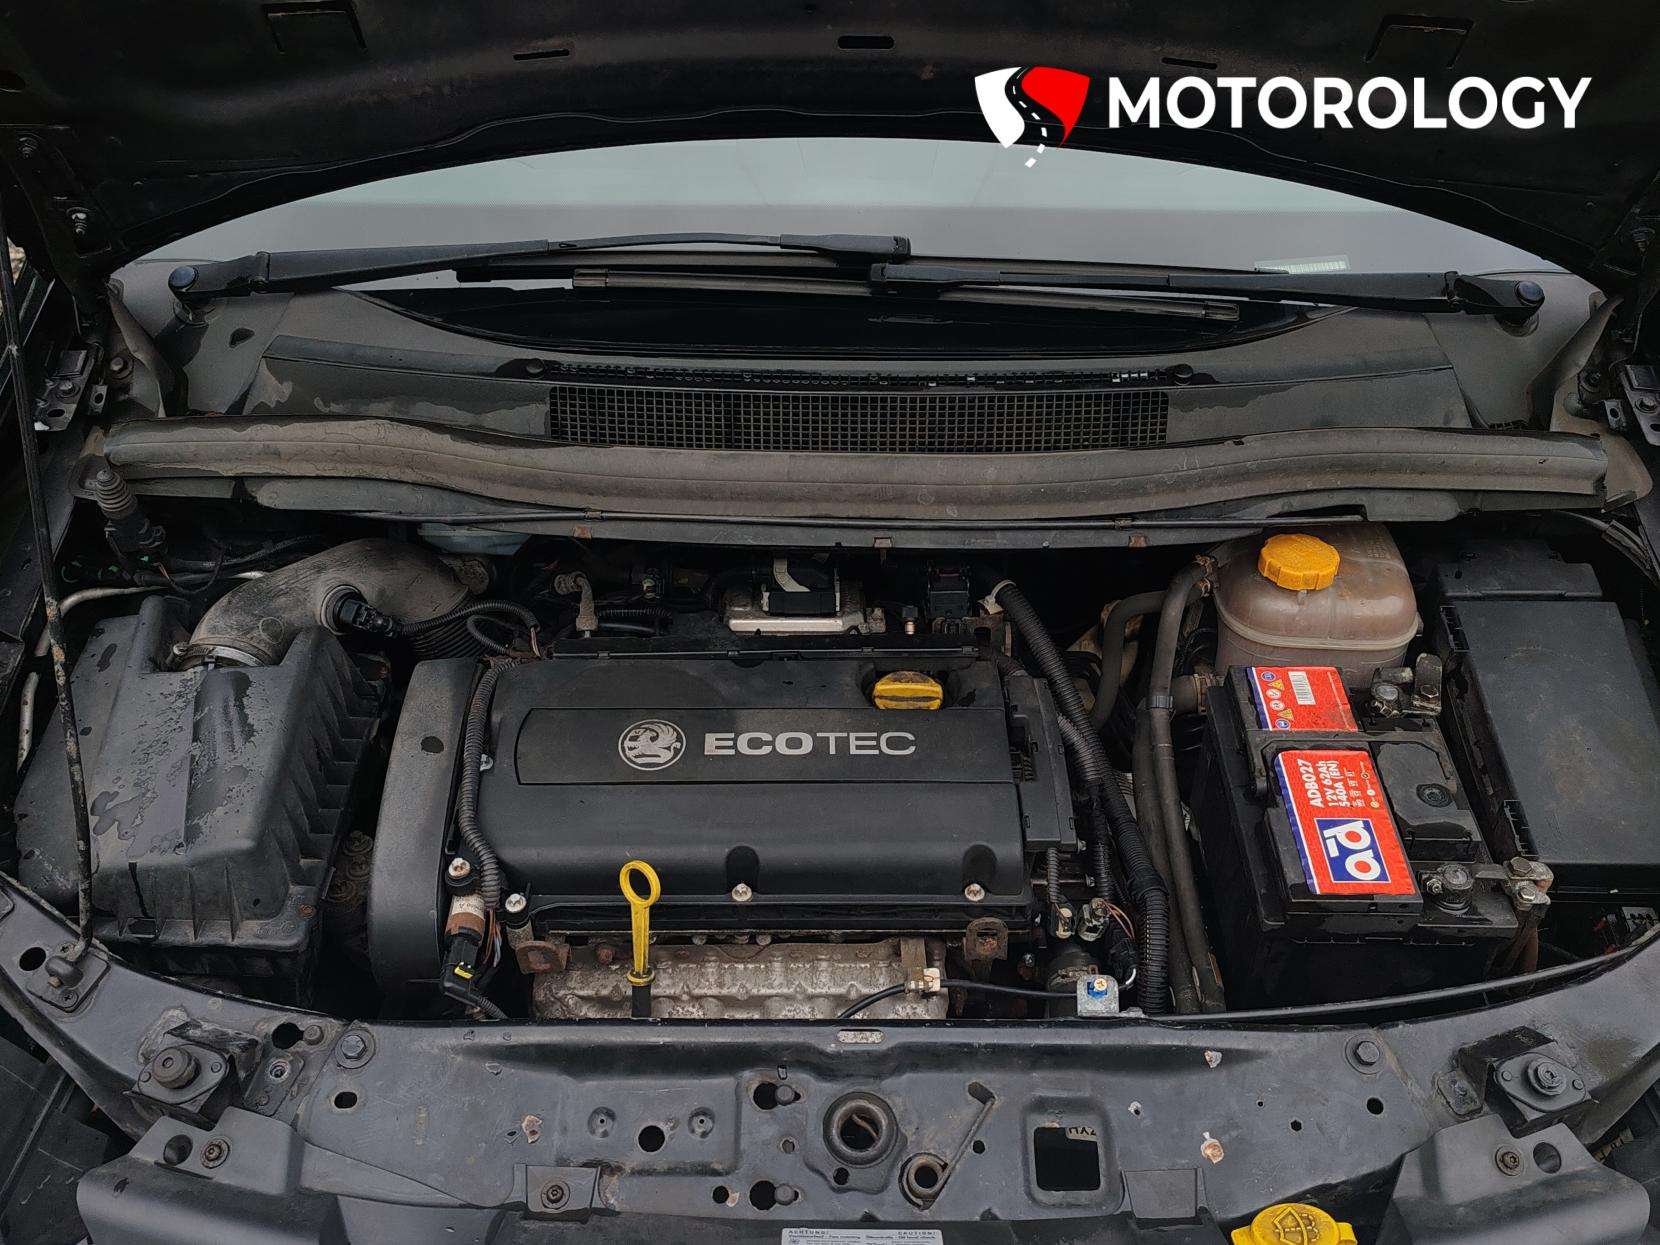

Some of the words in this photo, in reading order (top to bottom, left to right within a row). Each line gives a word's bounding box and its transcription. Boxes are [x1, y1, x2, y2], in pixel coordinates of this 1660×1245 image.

[704, 731, 916, 756] ECOTEC
[1297, 758, 1324, 808] ADB027
[1315, 760, 1333, 786] 62Ah
[1325, 788, 1339, 807] 12V
[1333, 781, 1350, 807] 540A
